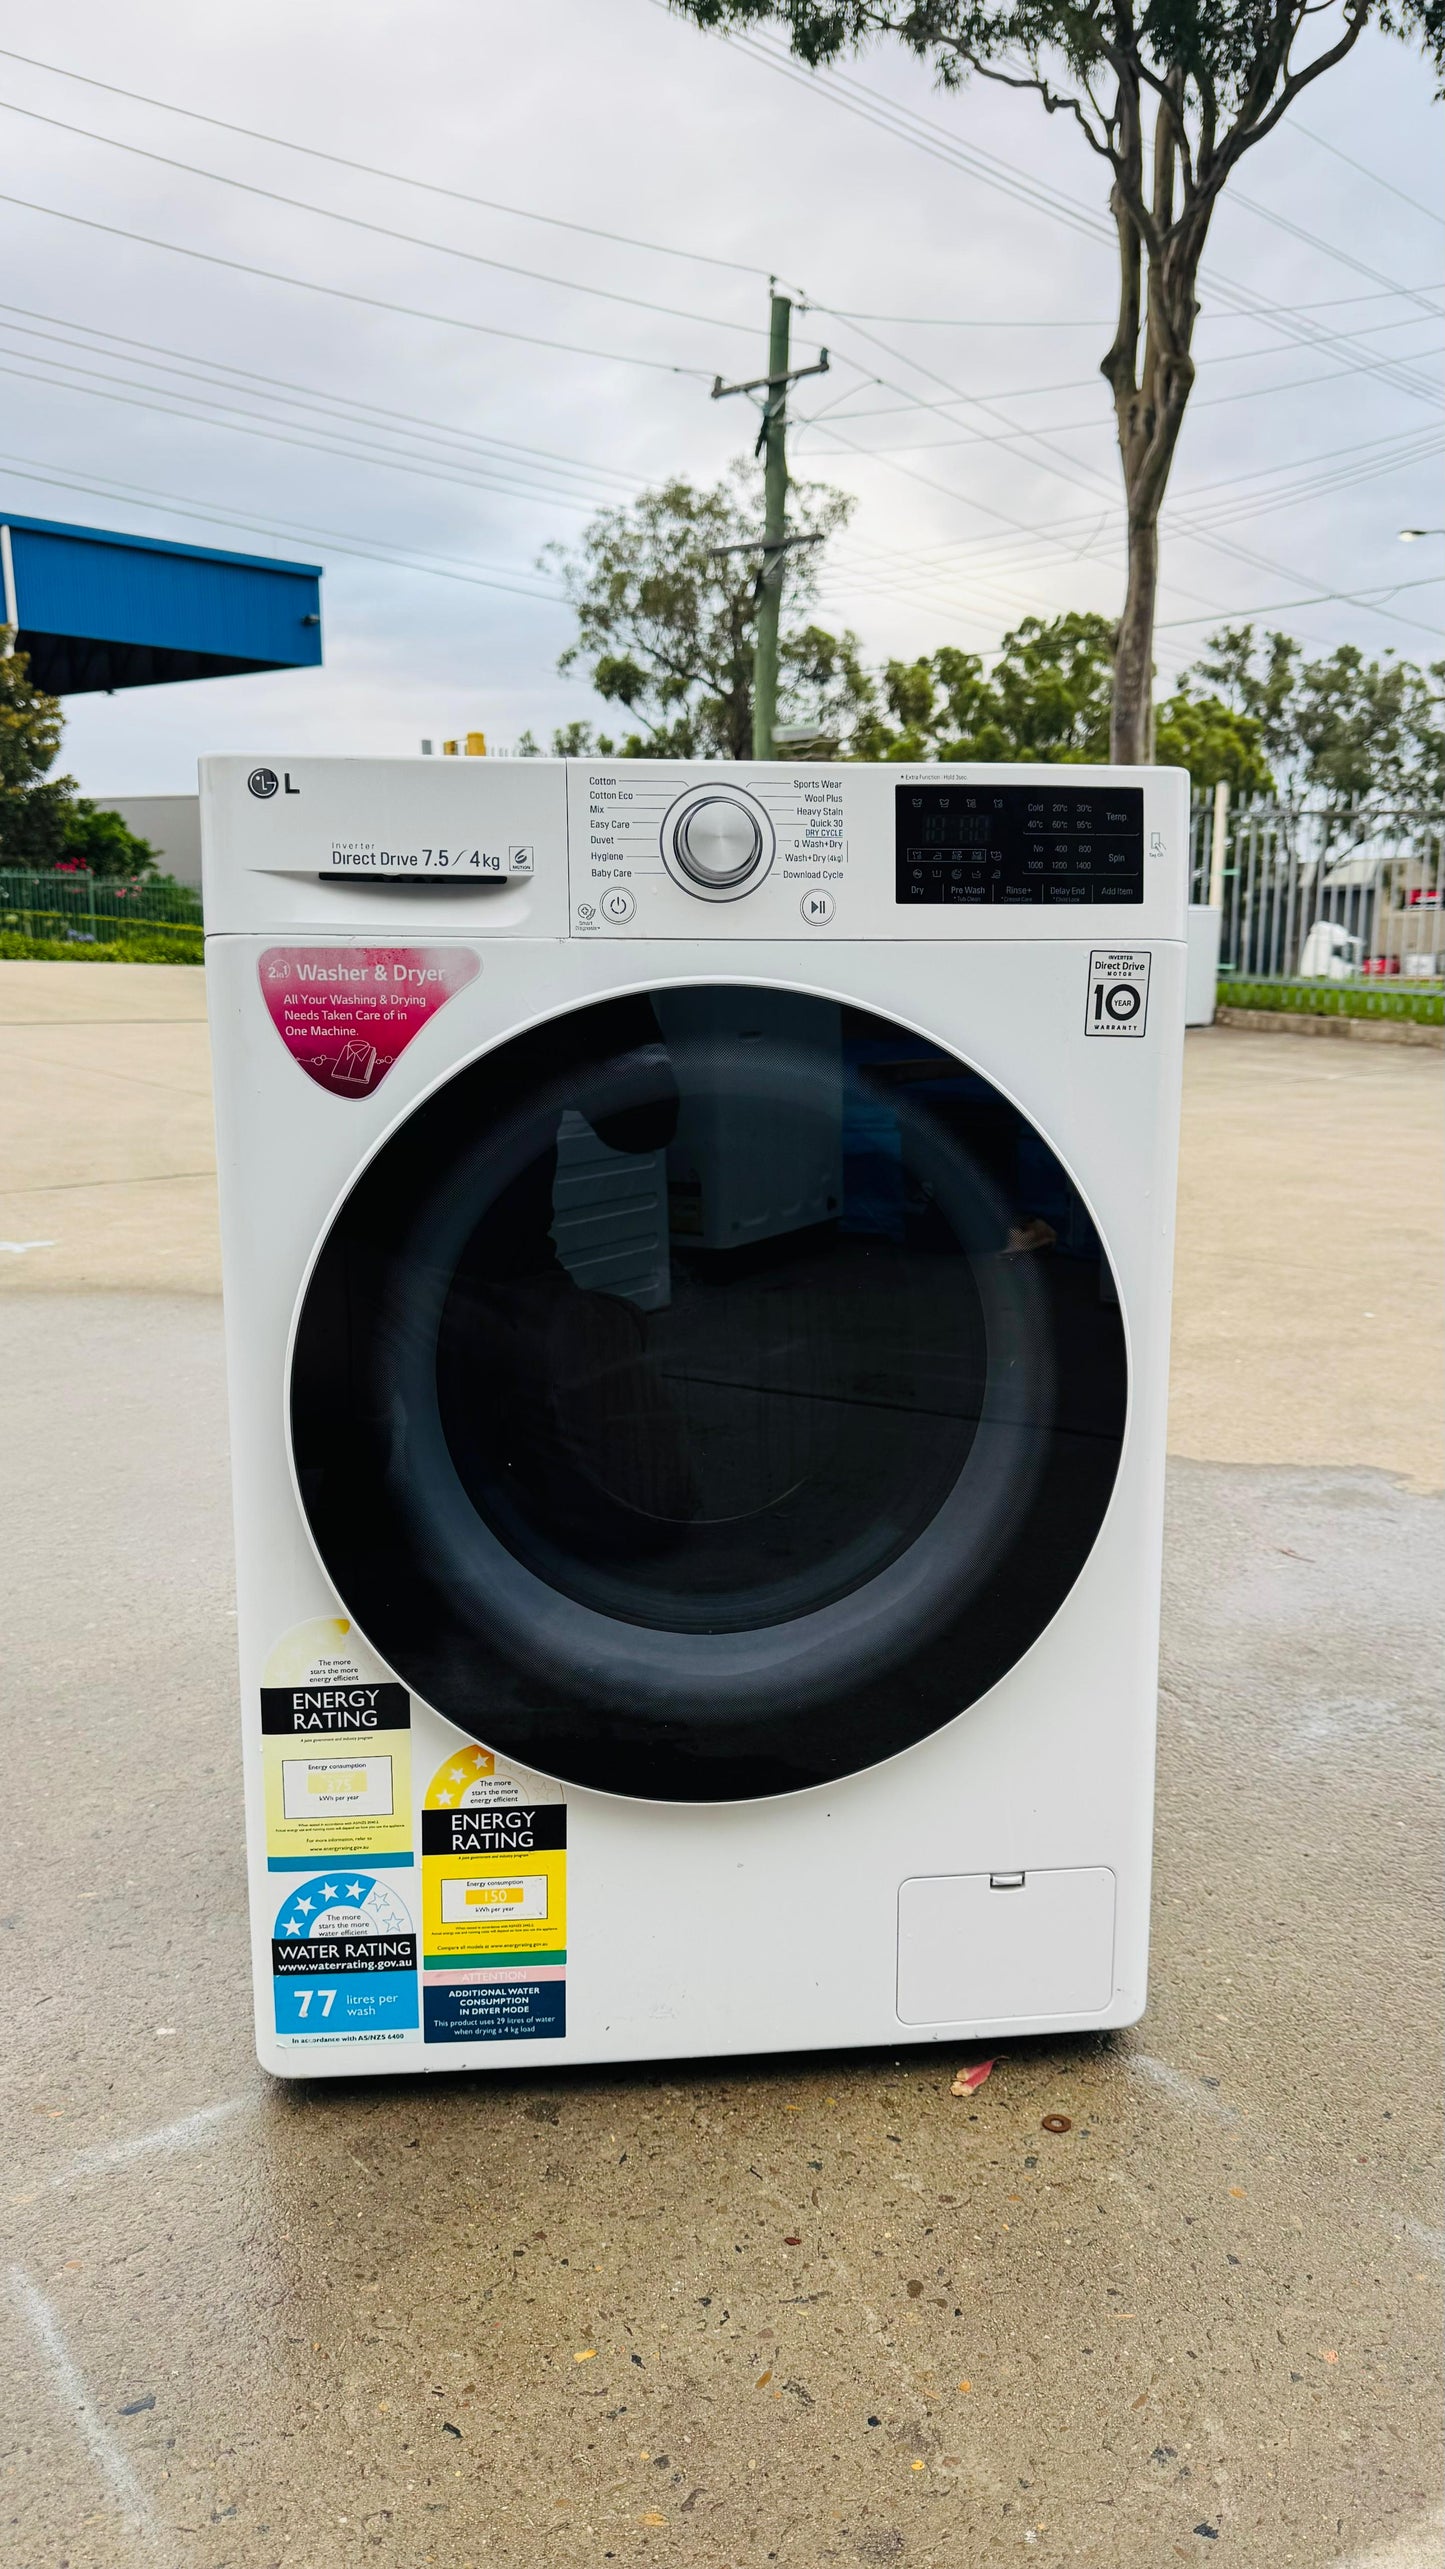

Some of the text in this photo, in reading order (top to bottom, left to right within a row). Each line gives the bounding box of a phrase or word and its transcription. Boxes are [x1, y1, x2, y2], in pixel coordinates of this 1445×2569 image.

[285, 773, 300, 794] L
[590, 777, 616, 786] Cotton
[794, 779, 842, 790] Sports Wear
[590, 792, 634, 800] Cotton Eco
[804, 794, 842, 802] Wool Plus
[590, 805, 604, 814] Mix
[796, 807, 844, 818] Heavy Stain
[1028, 804, 1044, 812] Cold
[590, 820, 630, 830] Easy Care
[810, 819, 844, 828] Quick 30
[806, 828, 843, 837] DRY CYCLE
[590, 836, 614, 845] Duvet
[1033, 844, 1044, 853] No
[1055, 844, 1068, 853] 400
[1078, 844, 1092, 853] 800
[332, 851, 376, 866] Direct
[381, 852, 418, 866] Drive
[591, 852, 624, 862] Hygiene
[785, 854, 844, 864] Wash+Dry (4kg)
[1108, 854, 1126, 864] Spin
[1028, 861, 1044, 870] 1000
[1052, 861, 1068, 870] 1200
[1076, 861, 1092, 870] 1400
[592, 869, 632, 880] Baby Care
[783, 870, 844, 880] Download Cycle
[911, 886, 924, 896] Dry
[951, 886, 986, 894] Pre Wash
[1006, 886, 1032, 894] Rinse+
[1050, 886, 1086, 896] Delay End
[1102, 887, 1133, 895] Add Item
[1095, 961, 1145, 970] Direct Drive
[297, 964, 368, 982] Washer
[374, 965, 388, 982] &
[394, 964, 445, 986] Dryer
[284, 994, 426, 1008] All Your Washing & Drying
[1094, 984, 1141, 1021] 10
[284, 1010, 408, 1020] Needs Taken Care of in
[285, 1026, 359, 1036] One Machine.
[292, 1690, 380, 1710] ENERGY
[294, 1710, 378, 1730] RATING
[329, 1762, 366, 1770] consumption
[452, 1811, 536, 1831] ENERGY
[452, 1831, 534, 1850] RATING
[484, 1890, 507, 1903] 150
[278, 1942, 411, 1960] WATER RATING
[278, 1959, 412, 1972] www.waterrating.gov.au
[461, 1971, 528, 1982] ATTENTION
[448, 1987, 540, 1998] ADDITIONAL WATER
[294, 1990, 398, 2018] 77 litres per
[460, 1997, 529, 2006] CONSUMPTION
[347, 2006, 376, 2016] wash
[472, 2007, 500, 2015] DRYER
[502, 2006, 530, 2014] MODE
[450, 2018, 478, 2028] product
[474, 2028, 496, 2036] drying
[510, 2026, 519, 2034] kg
